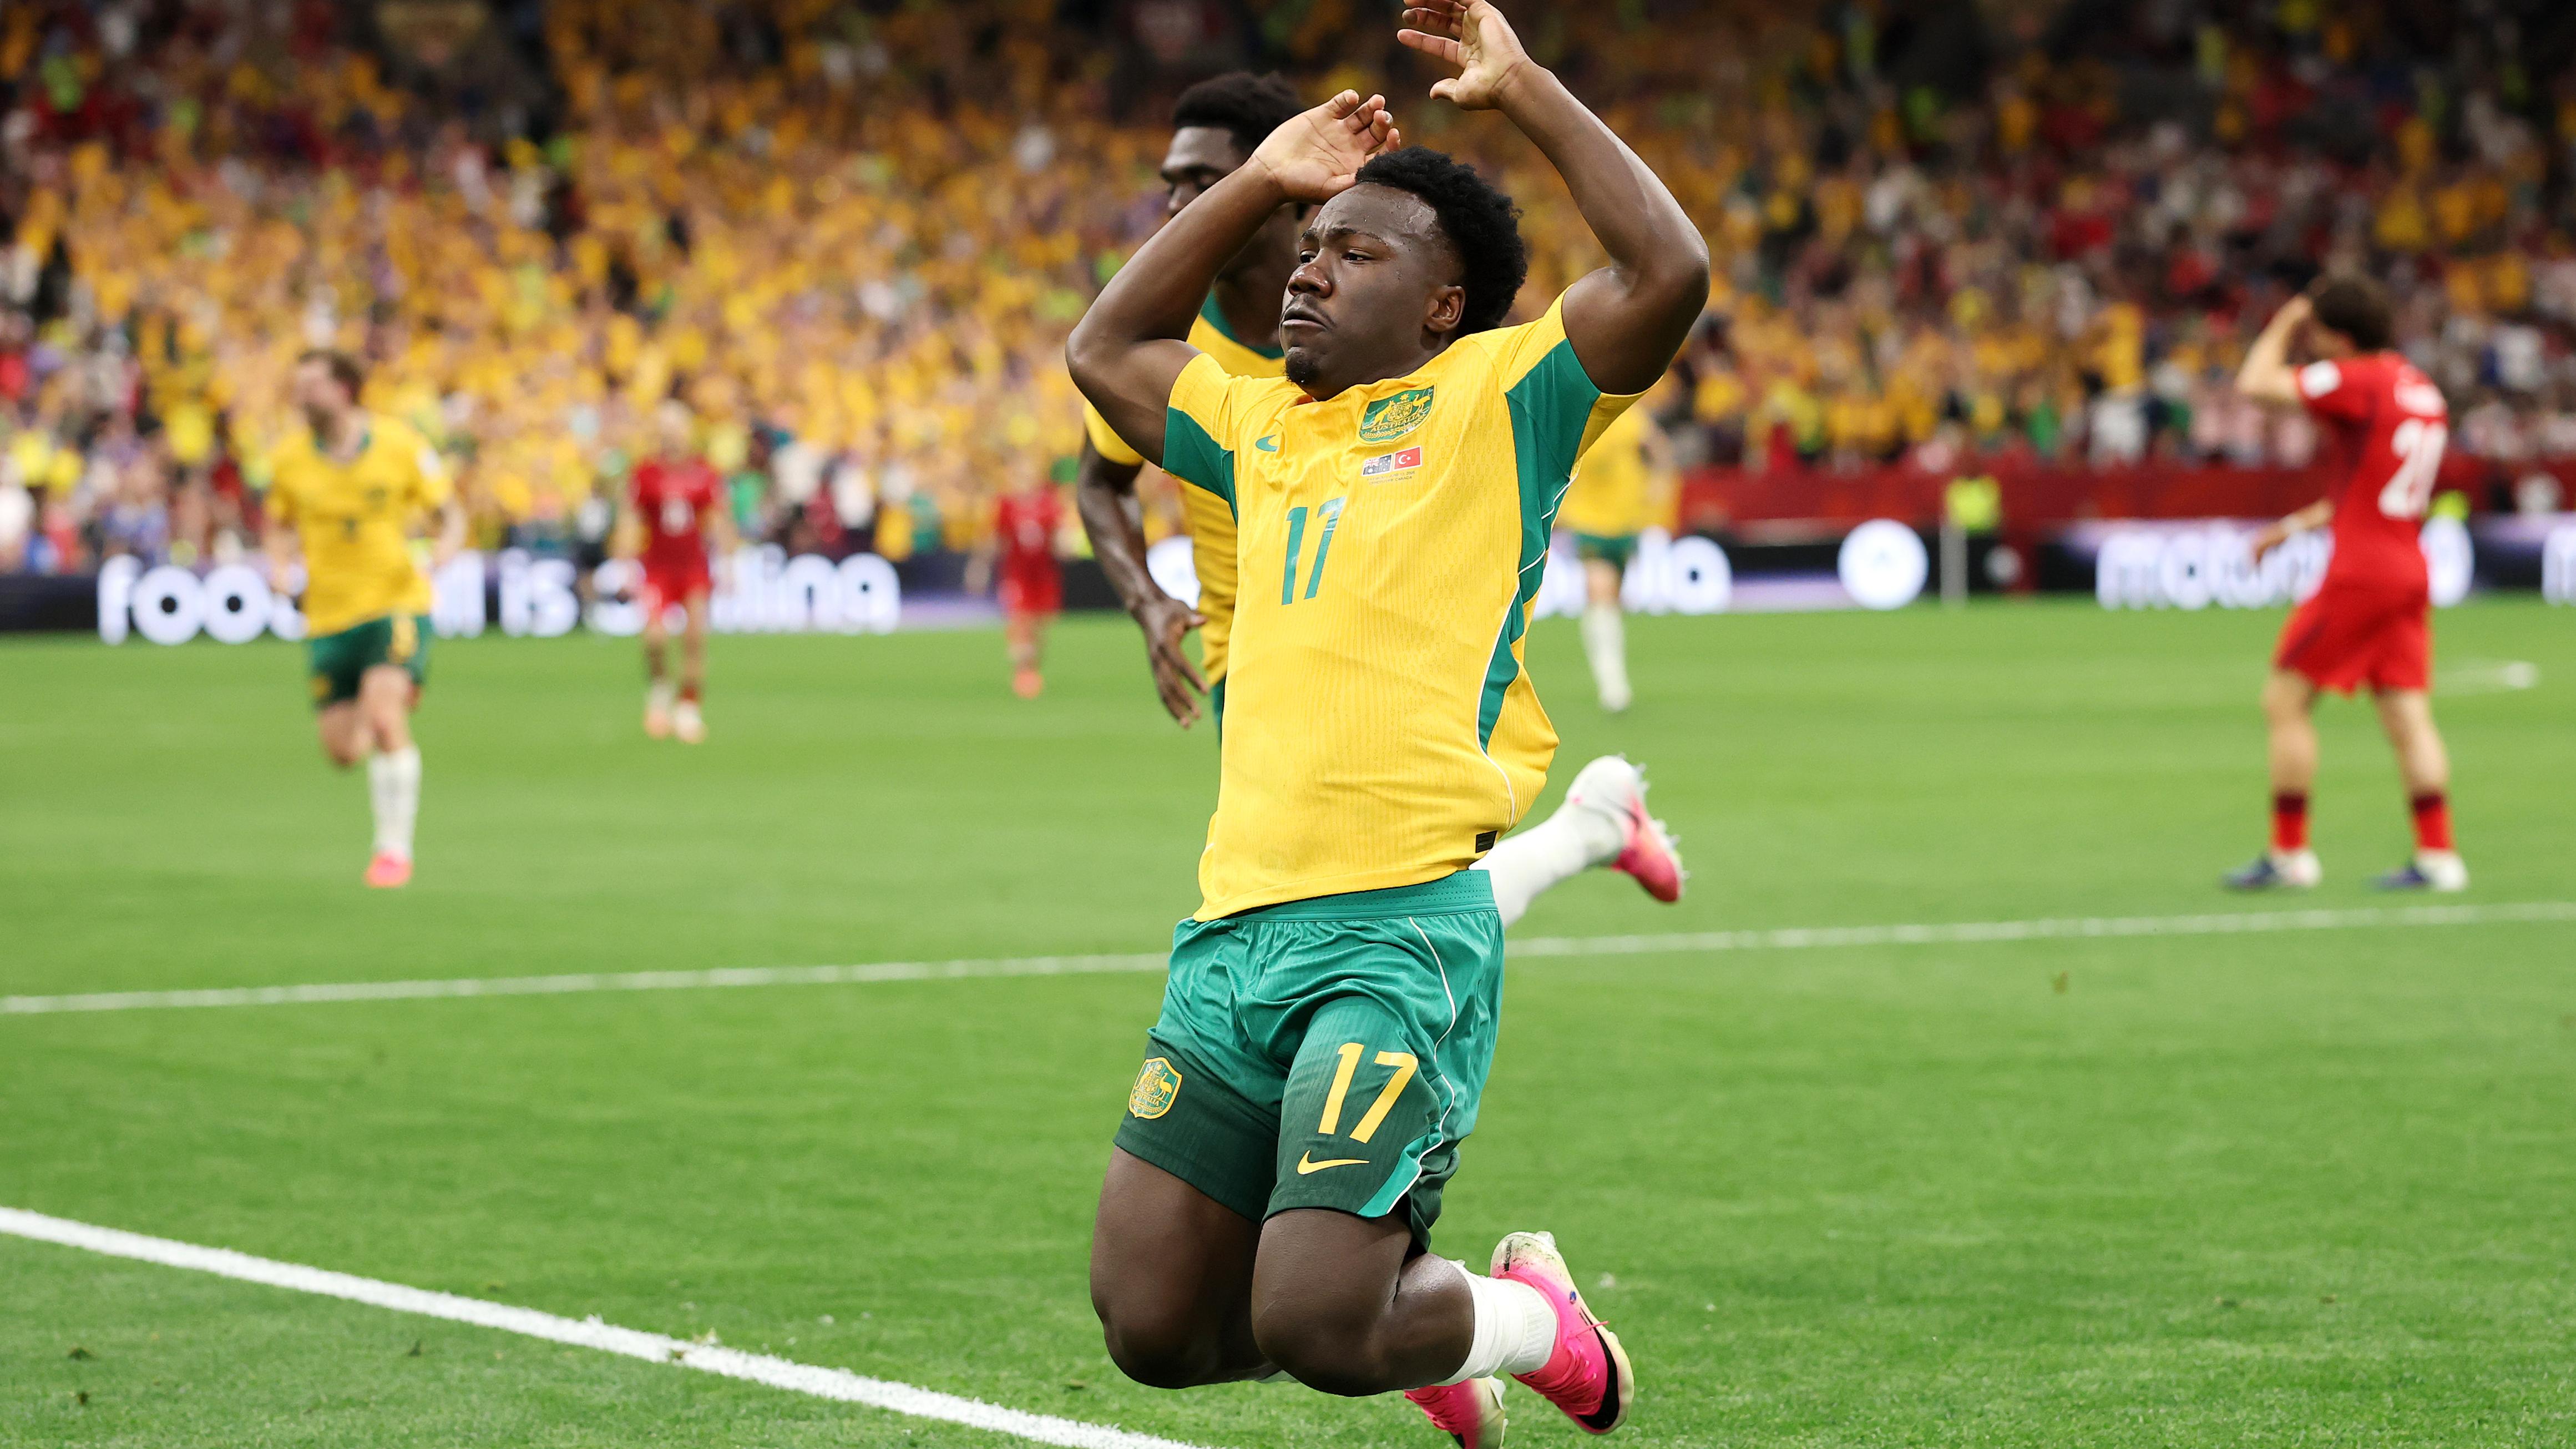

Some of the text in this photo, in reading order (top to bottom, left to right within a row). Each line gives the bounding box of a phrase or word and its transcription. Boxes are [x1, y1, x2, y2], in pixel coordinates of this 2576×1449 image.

[1371, 413, 1421, 432] AUSTRALIA
[98, 549, 485, 645] fooll
[499, 547, 579, 637] is
[592, 542, 900, 636] clling
[1282, 497, 1347, 605] 17
[1318, 1042, 1418, 1143] 17
